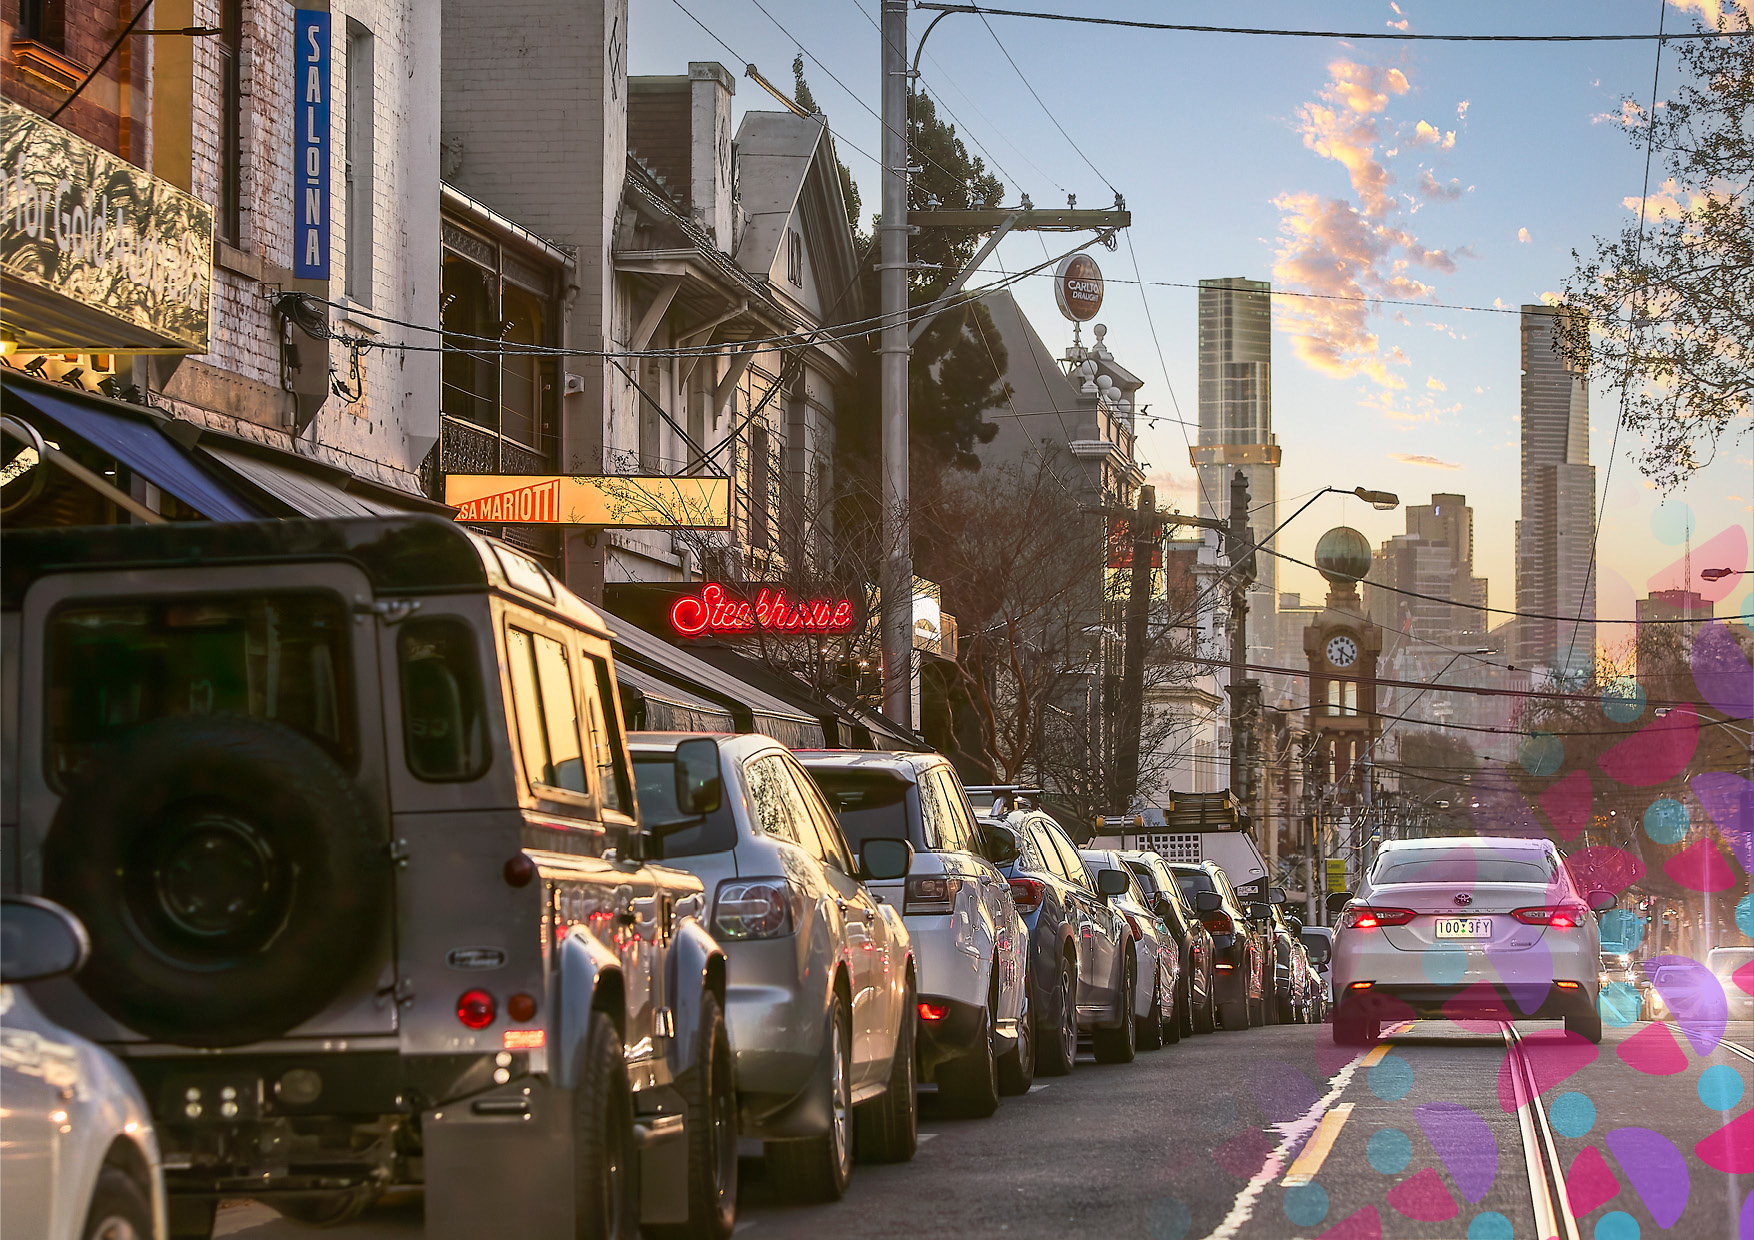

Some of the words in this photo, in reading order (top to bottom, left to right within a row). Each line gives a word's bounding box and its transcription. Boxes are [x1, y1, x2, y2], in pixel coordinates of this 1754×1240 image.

[15, 152, 50, 241] for
[55, 178, 107, 268] Gold
[480, 480, 559, 521] MARIOTTI
[670, 583, 853, 635] Steakhouse
